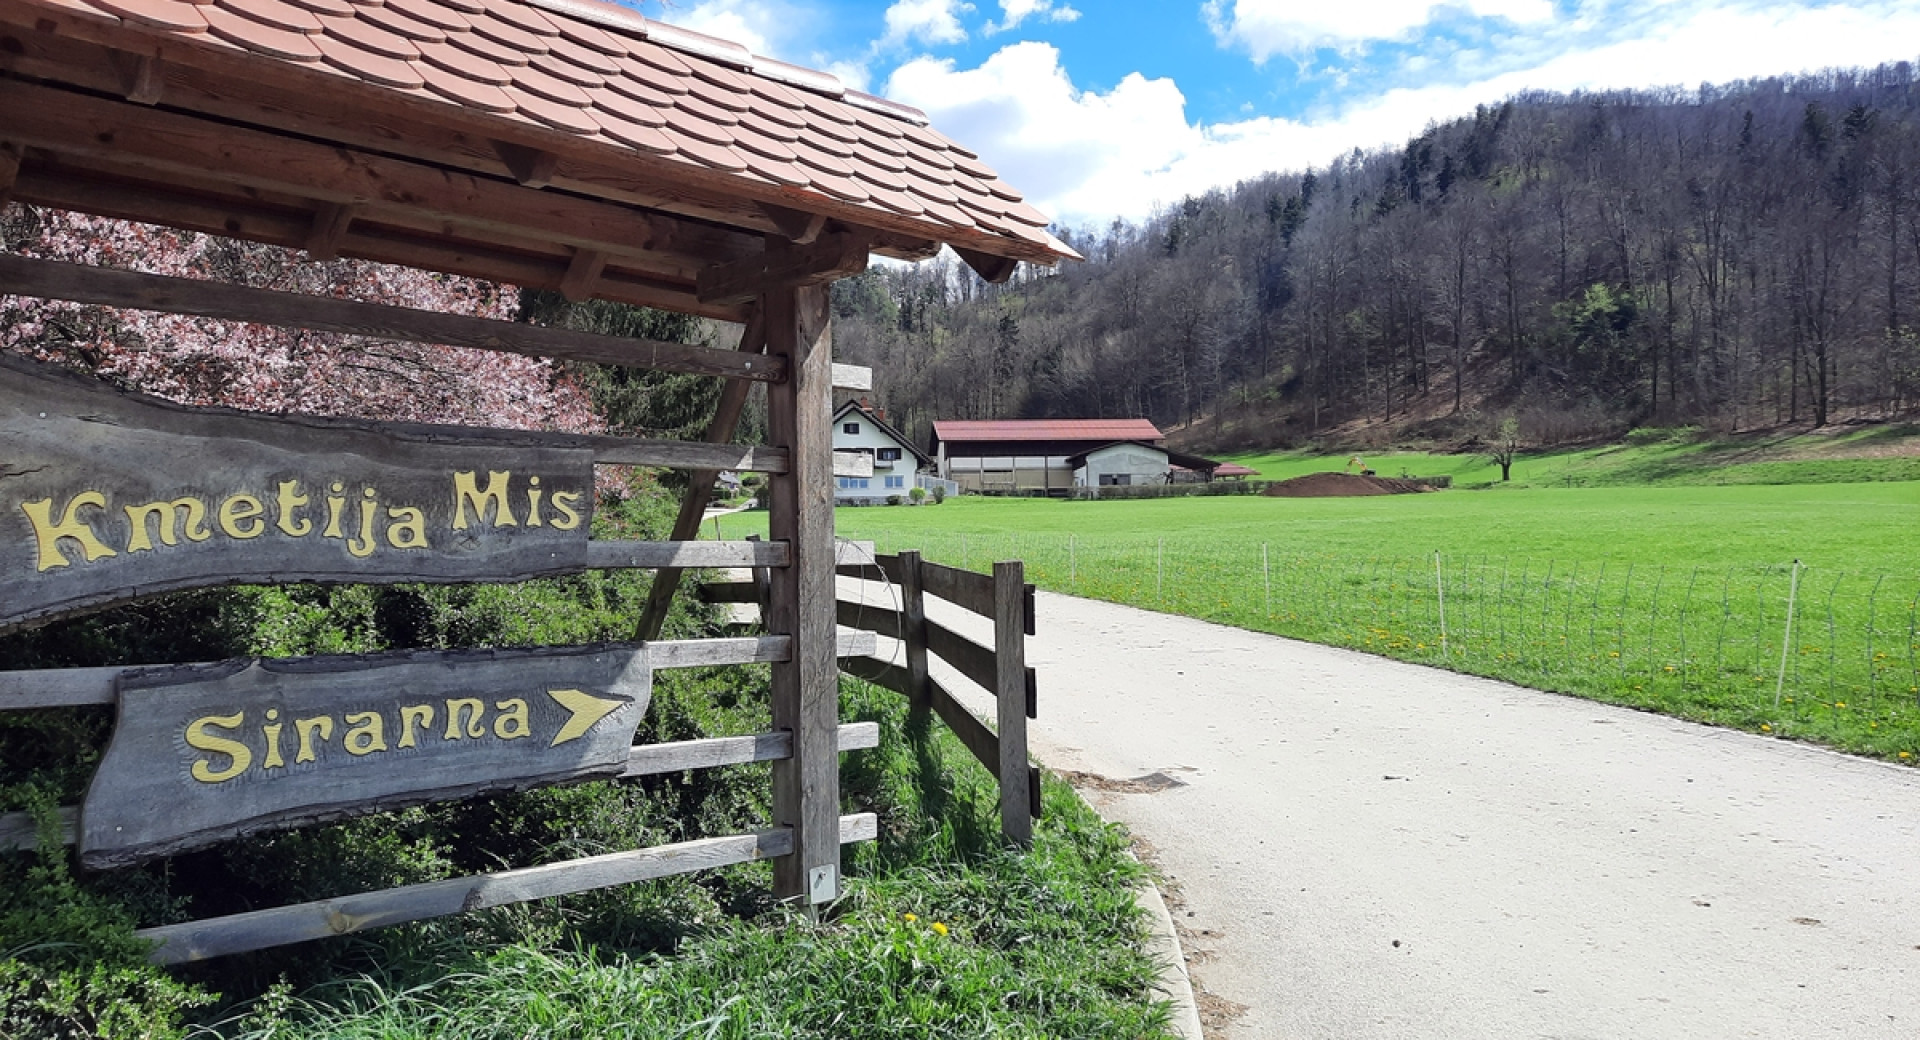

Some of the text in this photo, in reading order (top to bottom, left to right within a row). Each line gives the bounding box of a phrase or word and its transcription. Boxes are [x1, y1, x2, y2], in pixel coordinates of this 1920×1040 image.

[20, 470, 581, 573] Kmetija Mis
[184, 697, 531, 784] Sirarna
